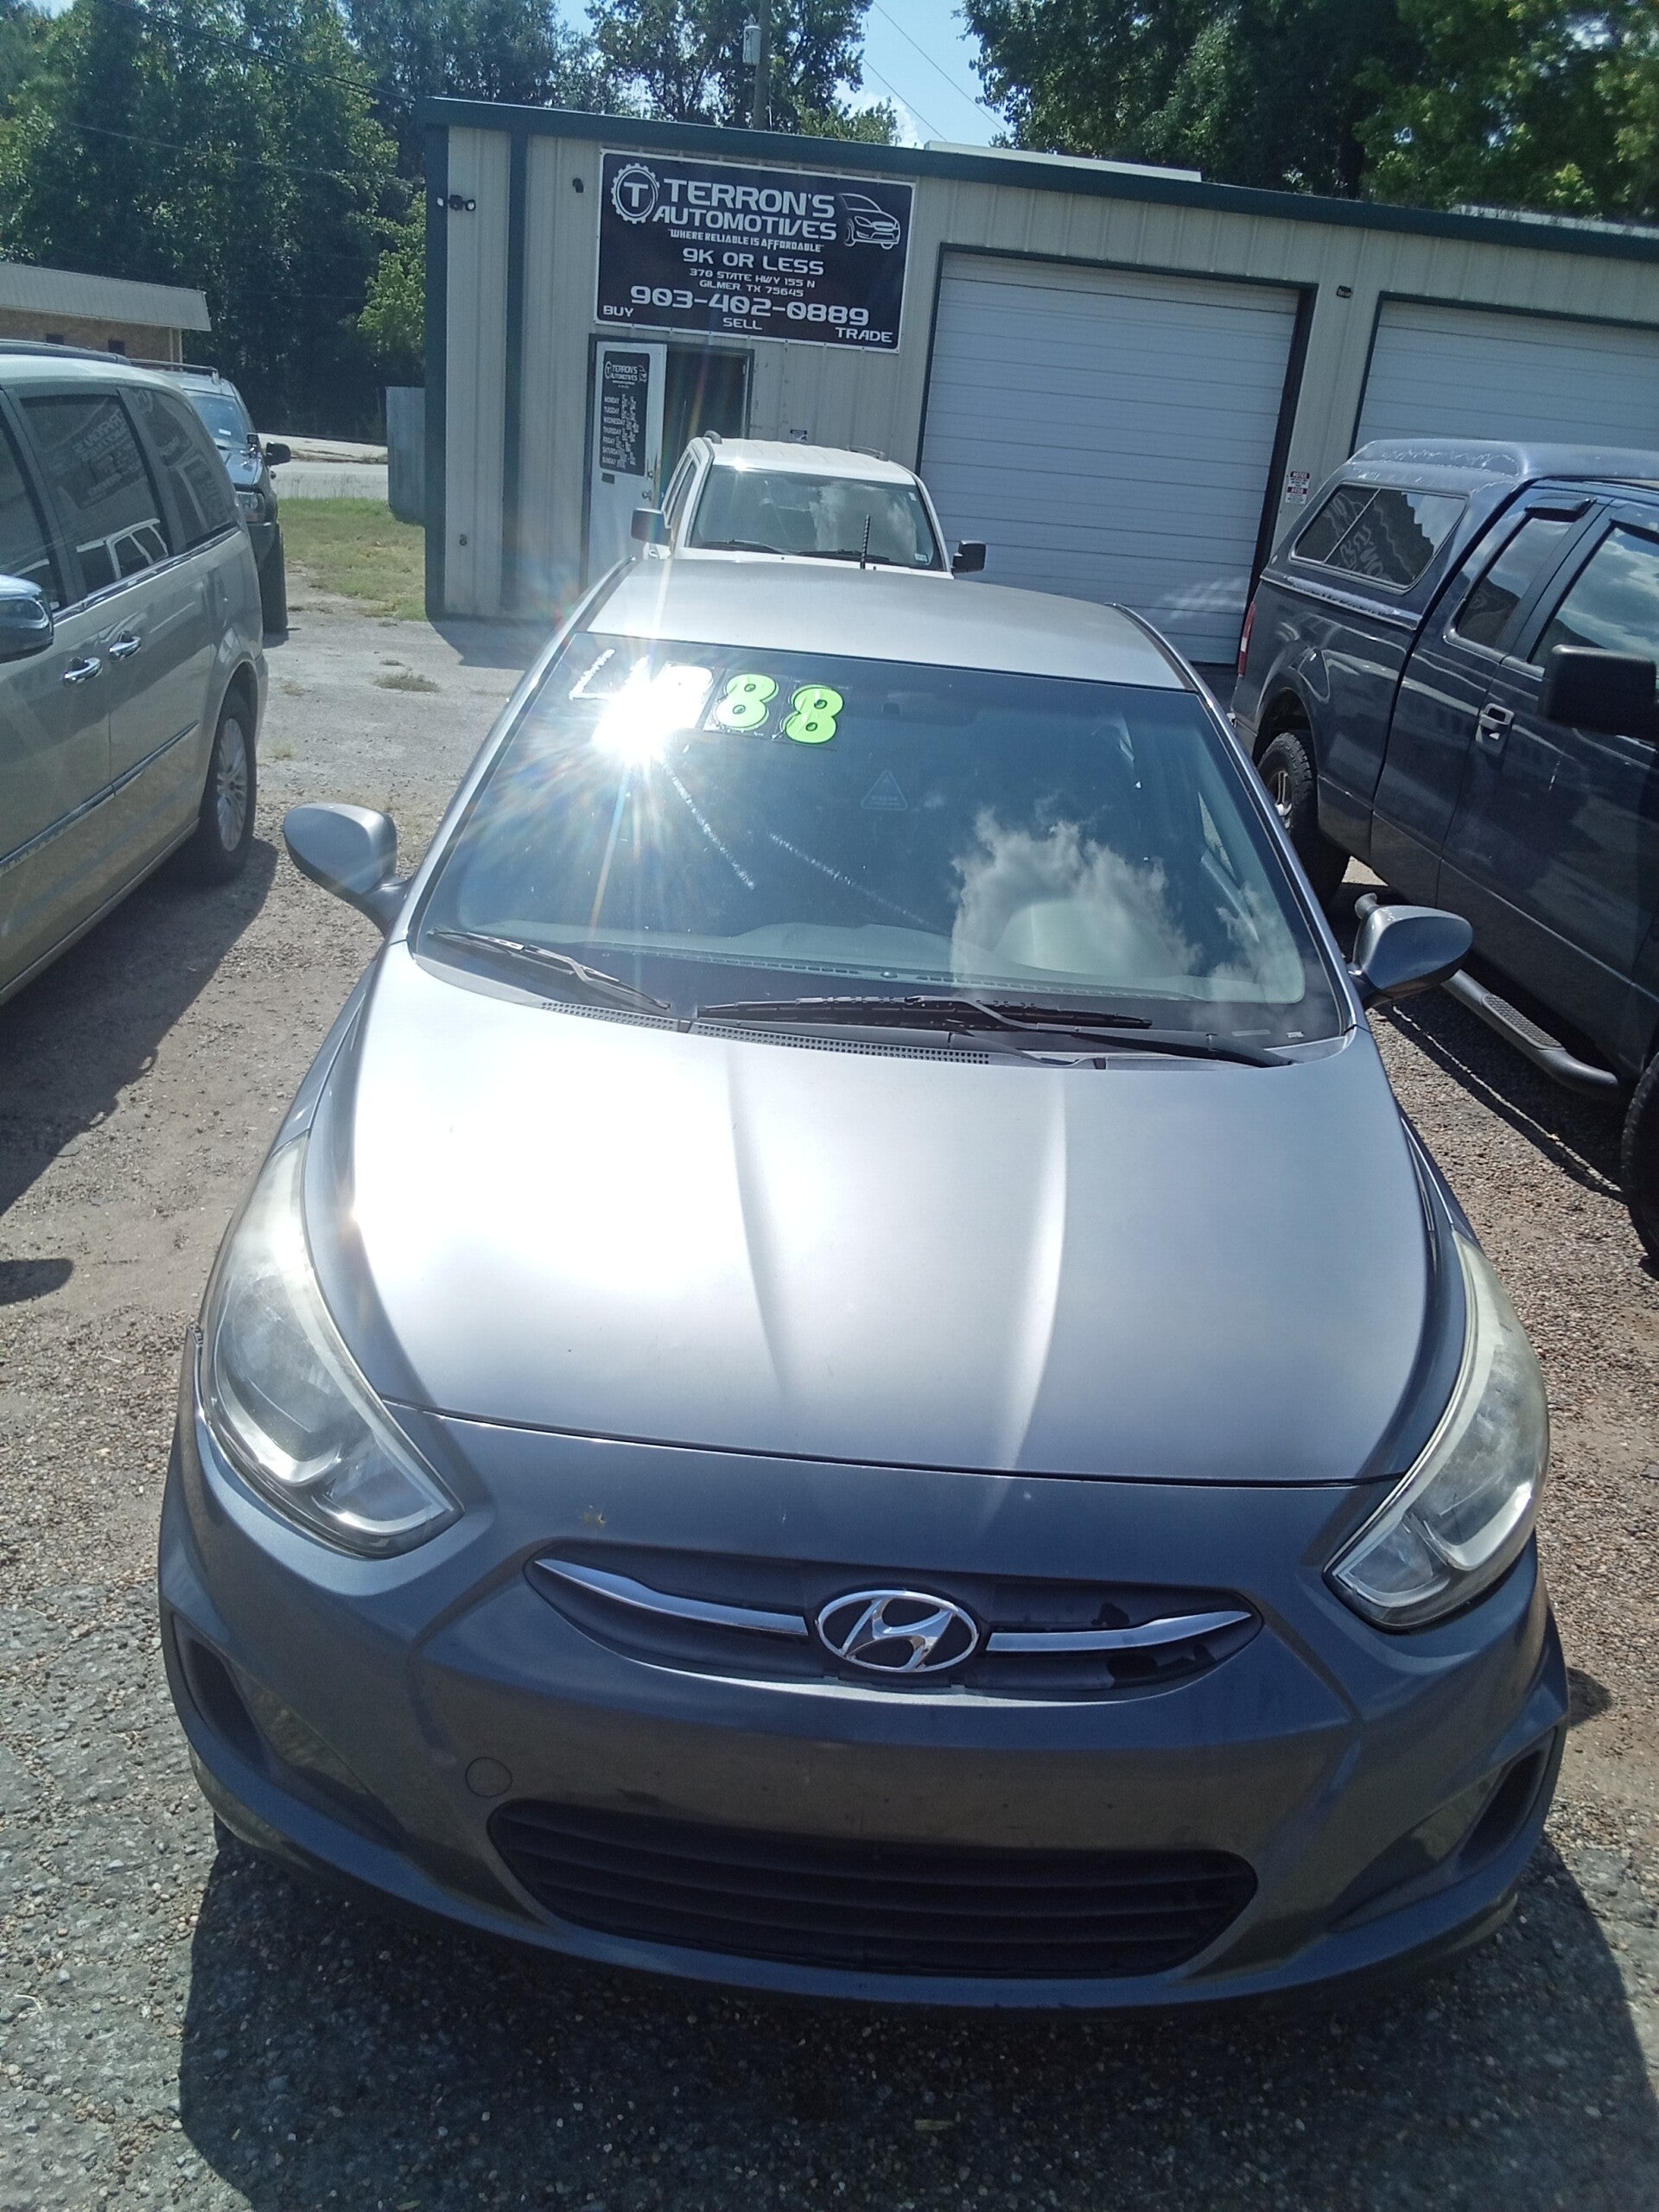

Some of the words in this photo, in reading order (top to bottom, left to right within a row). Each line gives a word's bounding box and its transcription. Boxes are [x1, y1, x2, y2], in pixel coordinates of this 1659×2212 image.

[623, 182, 649, 207] T
[664, 178, 835, 219] TERRON'S
[652, 205, 837, 241] AUTOMOTIVES
[704, 232, 749, 246] RELIABLE
[750, 237, 760, 246] IS
[683, 248, 715, 264] 9K
[723, 252, 753, 269] OR
[763, 257, 824, 276] LESS
[690, 269, 713, 278] 370
[717, 270, 752, 283] STATE
[755, 275, 780, 285] HWY
[785, 277, 804, 288] 155
[806, 280, 815, 289] N
[747, 283, 761, 294] TX
[765, 286, 804, 298] 75645
[603, 305, 634, 318] BUY
[631, 285, 869, 326] 903-402-0889
[723, 318, 762, 330] SELL
[836, 327, 893, 343] TRADE
